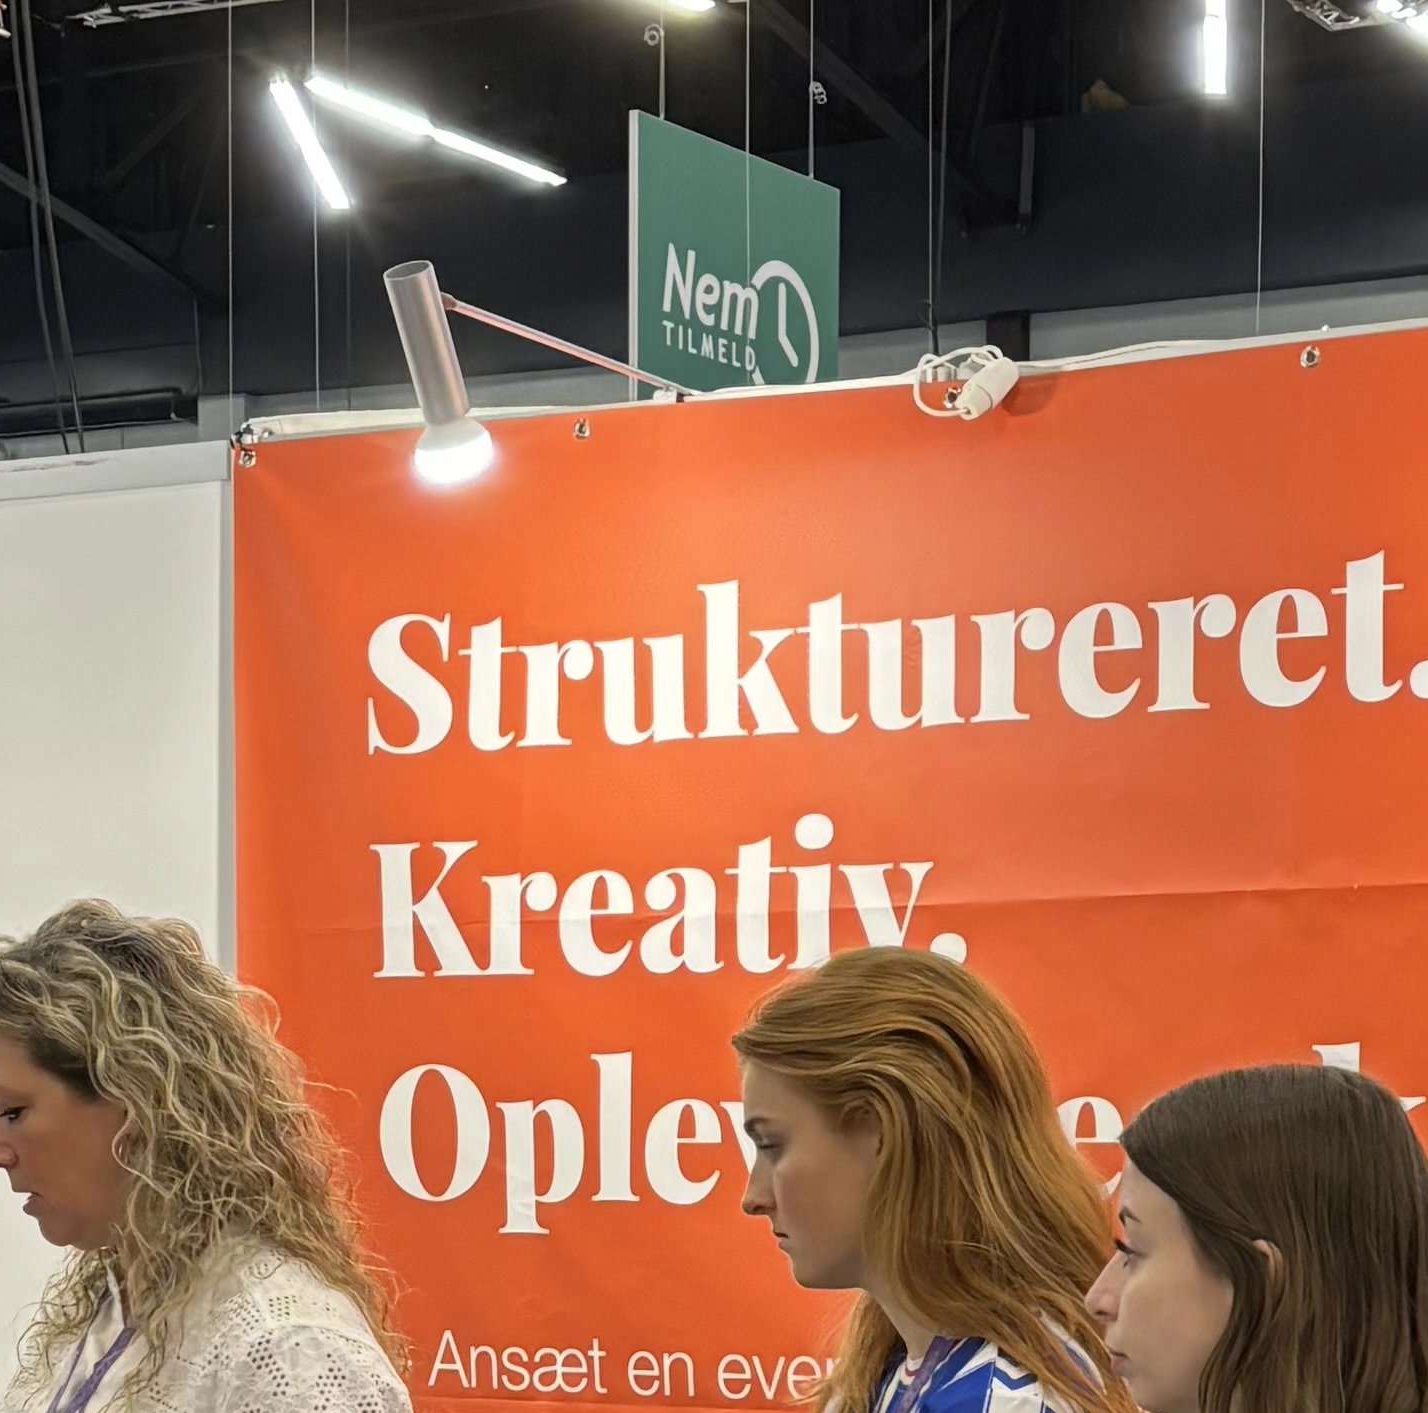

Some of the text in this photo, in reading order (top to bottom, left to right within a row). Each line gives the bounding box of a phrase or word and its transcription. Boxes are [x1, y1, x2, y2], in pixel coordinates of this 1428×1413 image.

[662, 242, 759, 340] Nem
[662, 319, 756, 373] TILMELD
[369, 813, 968, 978] Kreativ.
[428, 1329, 607, 1394] Ansæt
[627, 1351, 694, 1397] en
